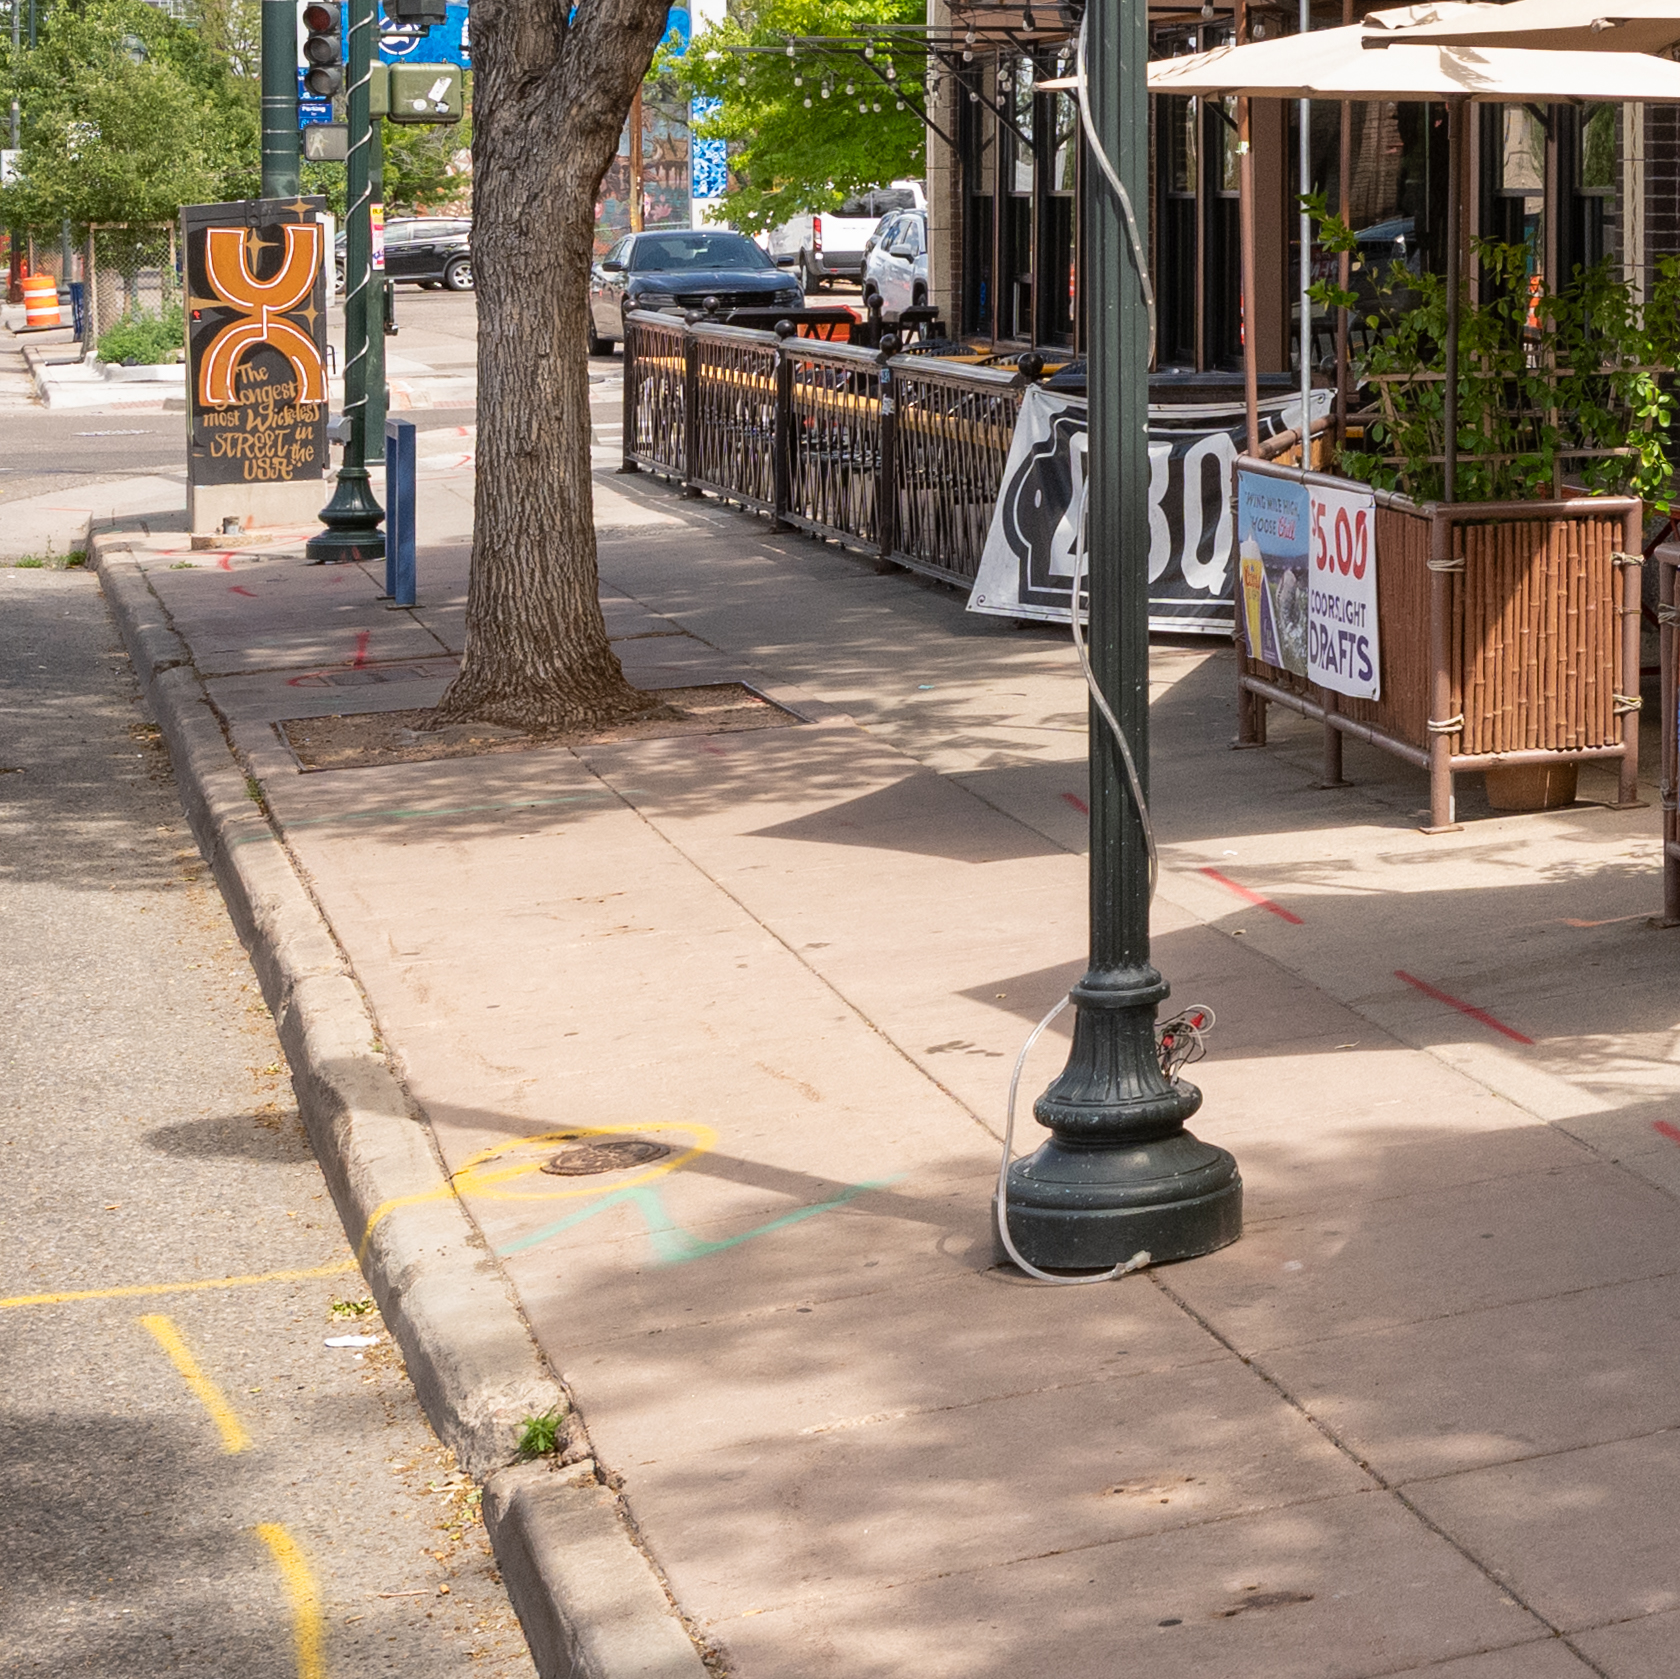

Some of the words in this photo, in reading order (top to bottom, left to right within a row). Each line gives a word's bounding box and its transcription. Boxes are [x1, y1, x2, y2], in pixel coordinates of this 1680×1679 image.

[235, 361, 269, 384] The
[203, 409, 240, 427] most
[210, 429, 291, 458] STREET
[294, 423, 315, 440] in
[289, 440, 315, 464] the
[1311, 499, 1368, 581] $5.00
[1310, 619, 1373, 682] DRAFTS
